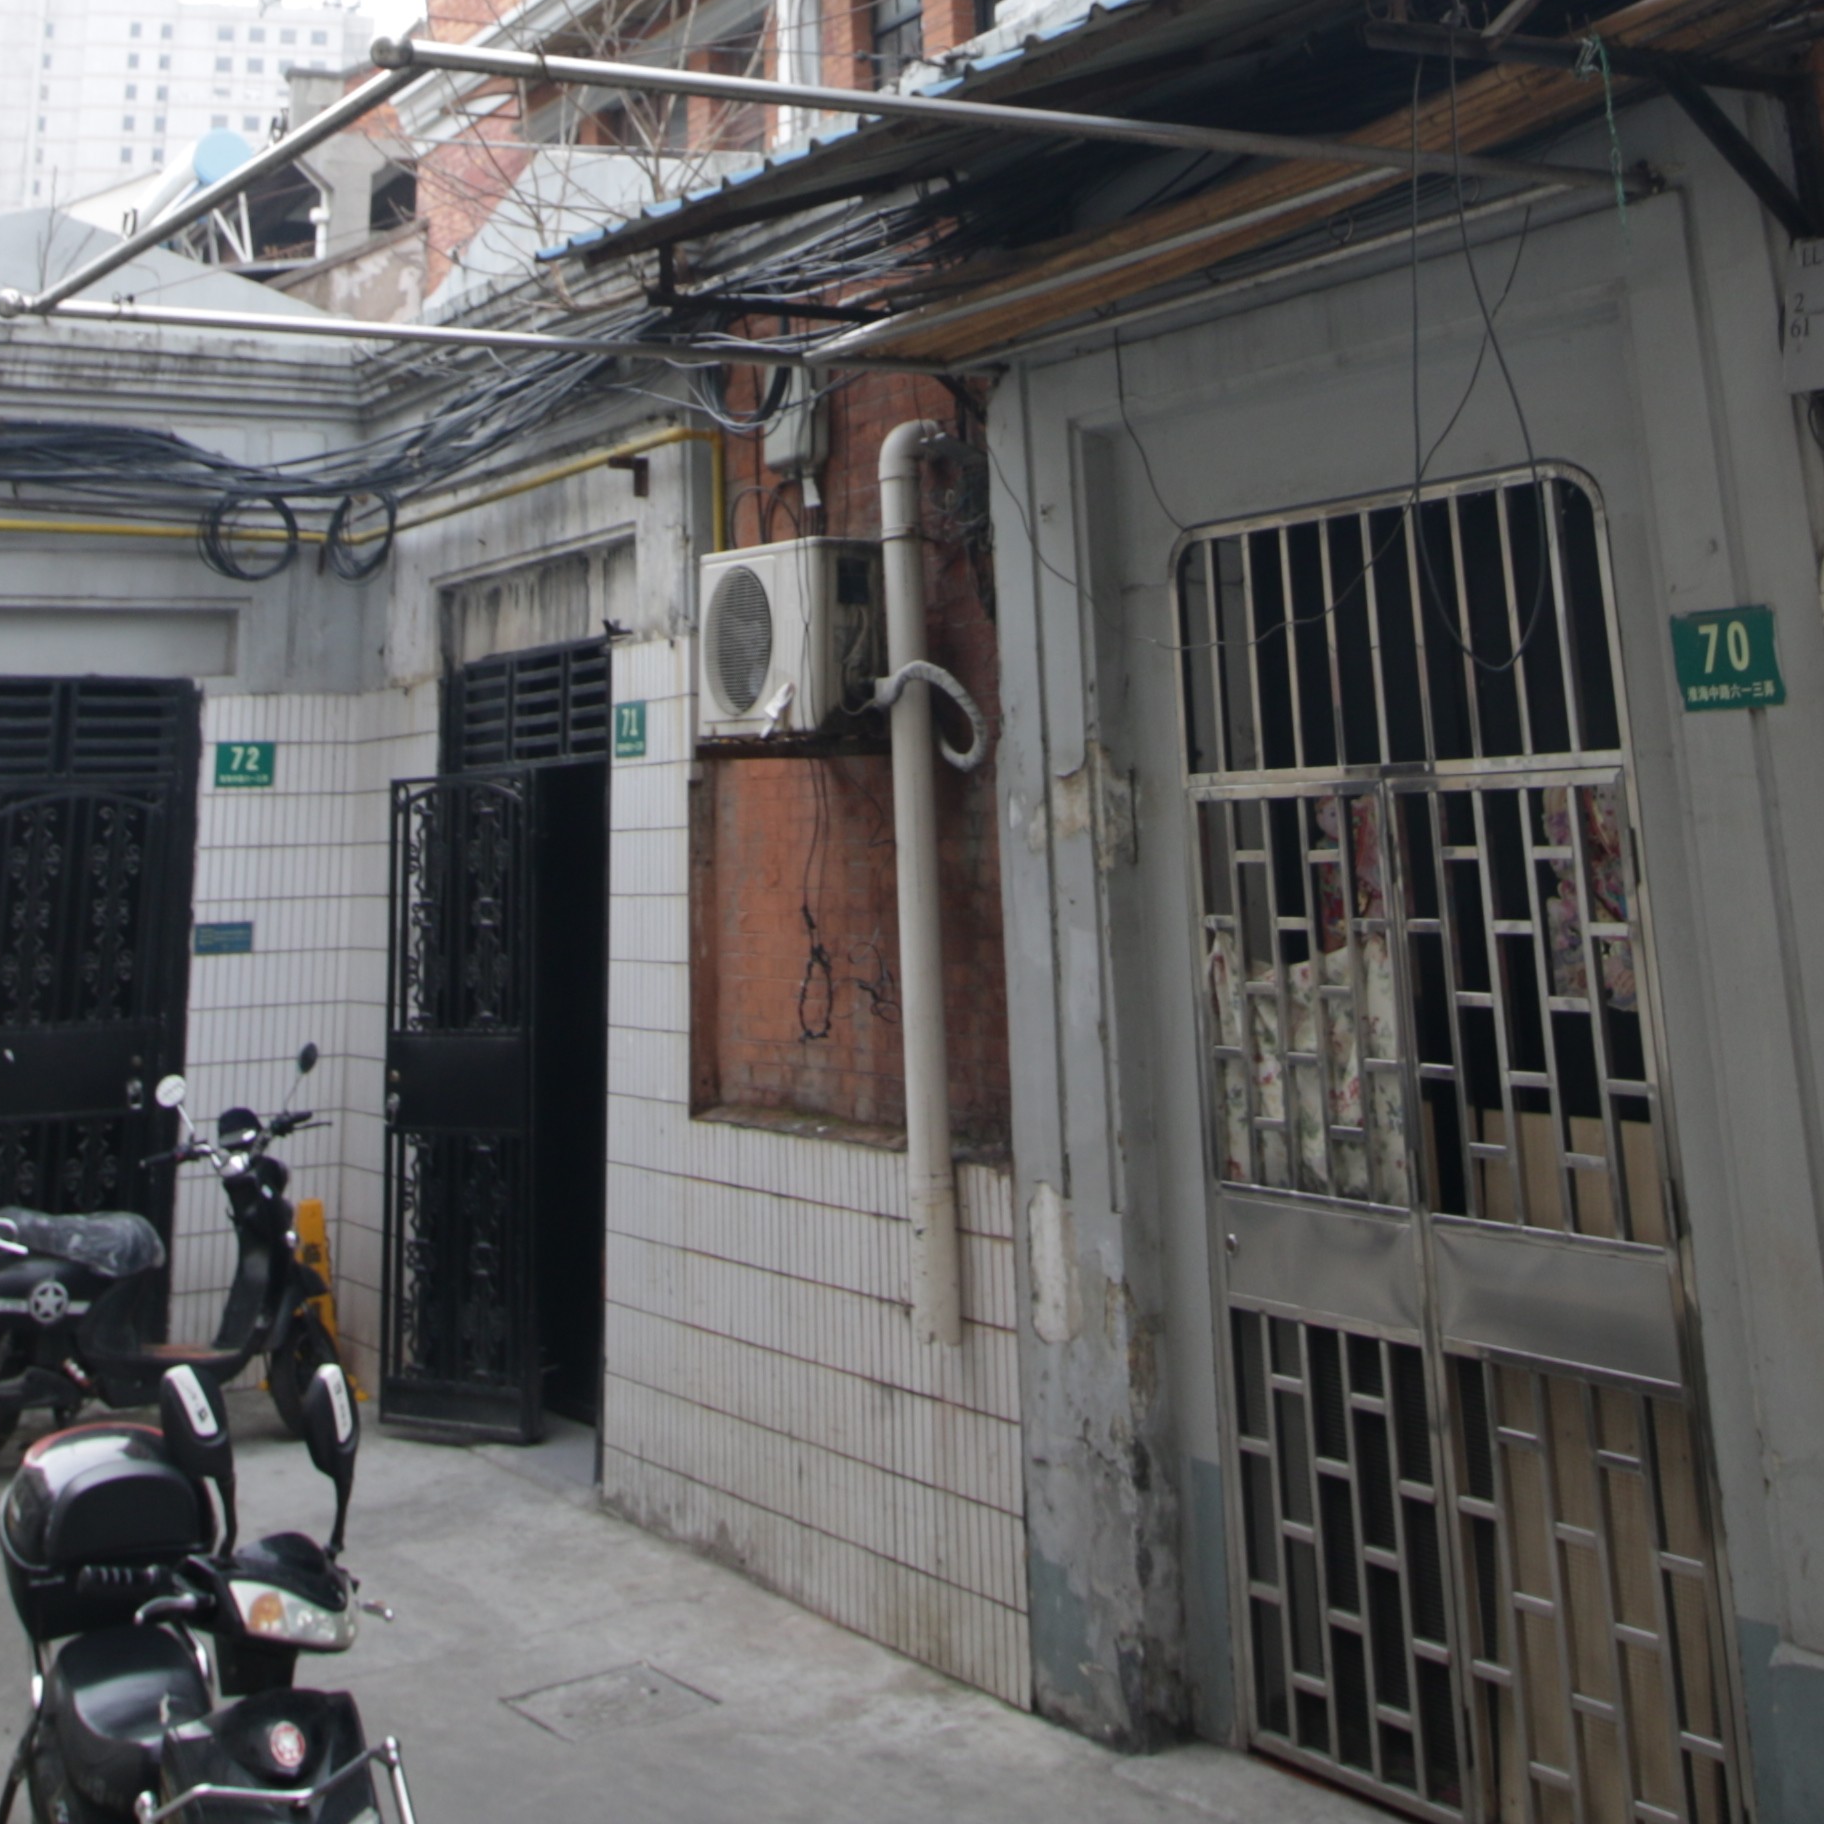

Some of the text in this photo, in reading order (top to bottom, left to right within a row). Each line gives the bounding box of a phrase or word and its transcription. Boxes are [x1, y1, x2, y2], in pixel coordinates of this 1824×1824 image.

[1794, 292, 1805, 314] 2
[1790, 317, 1810, 338] 61
[1698, 620, 1750, 674] 70
[1687, 679, 1776, 703] 淮海中路六一三弄
[621, 708, 639, 737] 71
[230, 745, 260, 772] 72
